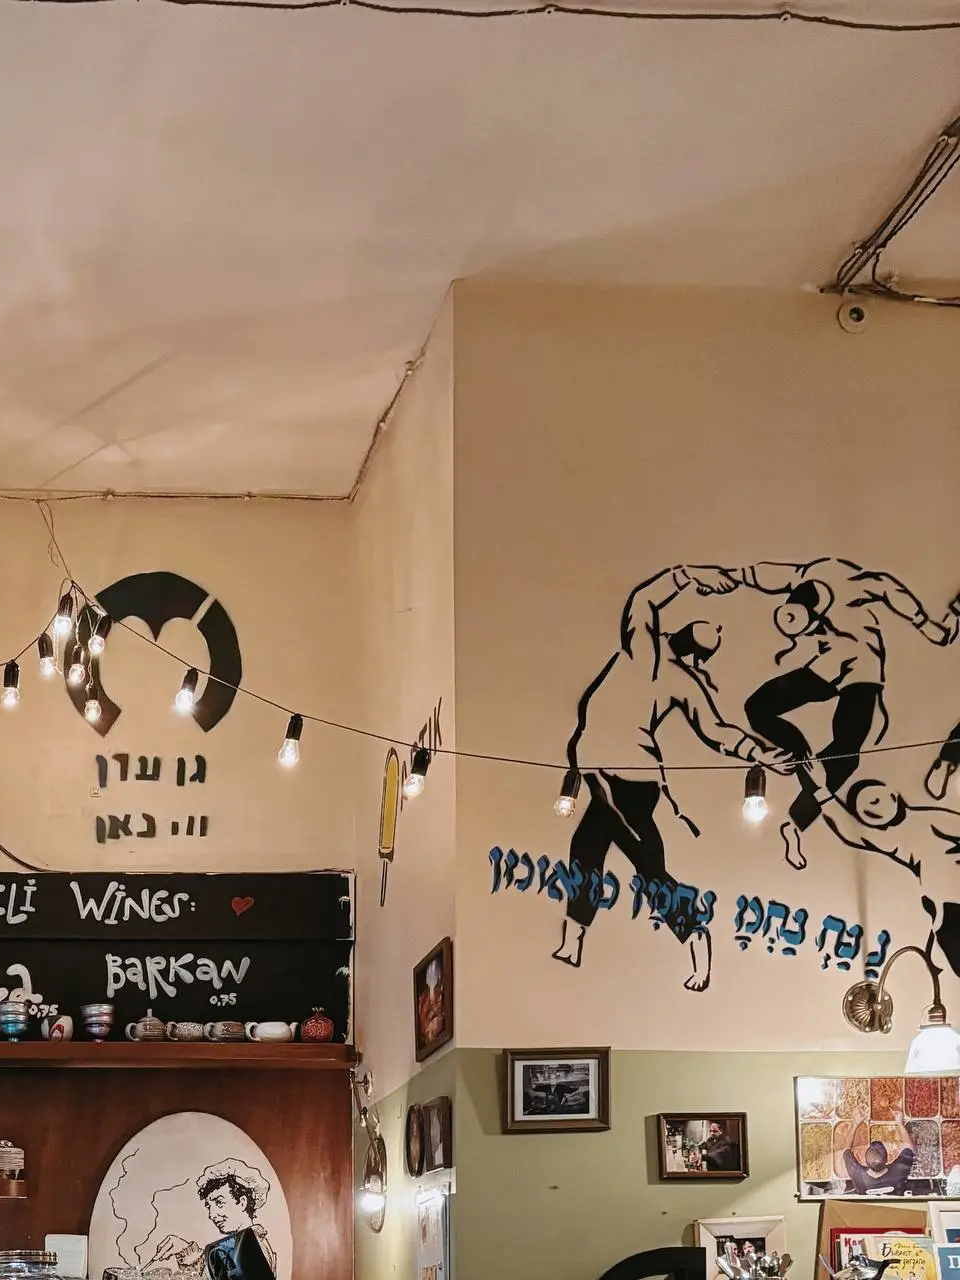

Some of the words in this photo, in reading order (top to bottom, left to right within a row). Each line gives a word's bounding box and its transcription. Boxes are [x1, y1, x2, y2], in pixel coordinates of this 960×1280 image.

[176, 754, 207, 787] גן
[95, 812, 156, 844] כאן
[29, 1003, 59, 1019] 0,75
[210, 992, 238, 1007] 0,75
